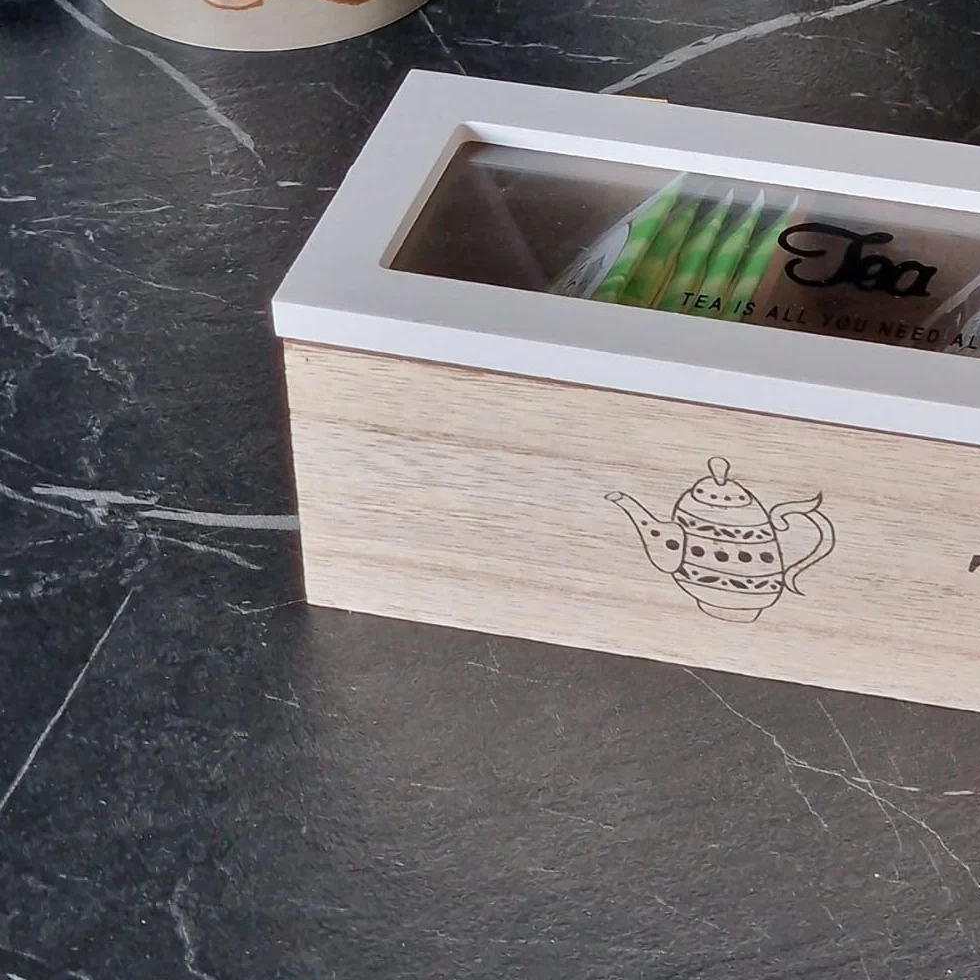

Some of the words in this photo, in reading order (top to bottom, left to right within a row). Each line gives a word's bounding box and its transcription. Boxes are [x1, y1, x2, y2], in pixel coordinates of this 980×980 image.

[777, 222, 938, 298] Tea
[681, 292, 722, 312] TEA
[734, 300, 756, 316] IS
[766, 306, 807, 325] ALL
[822, 313, 868, 334] YOU
[878, 321, 941, 344] NEED
